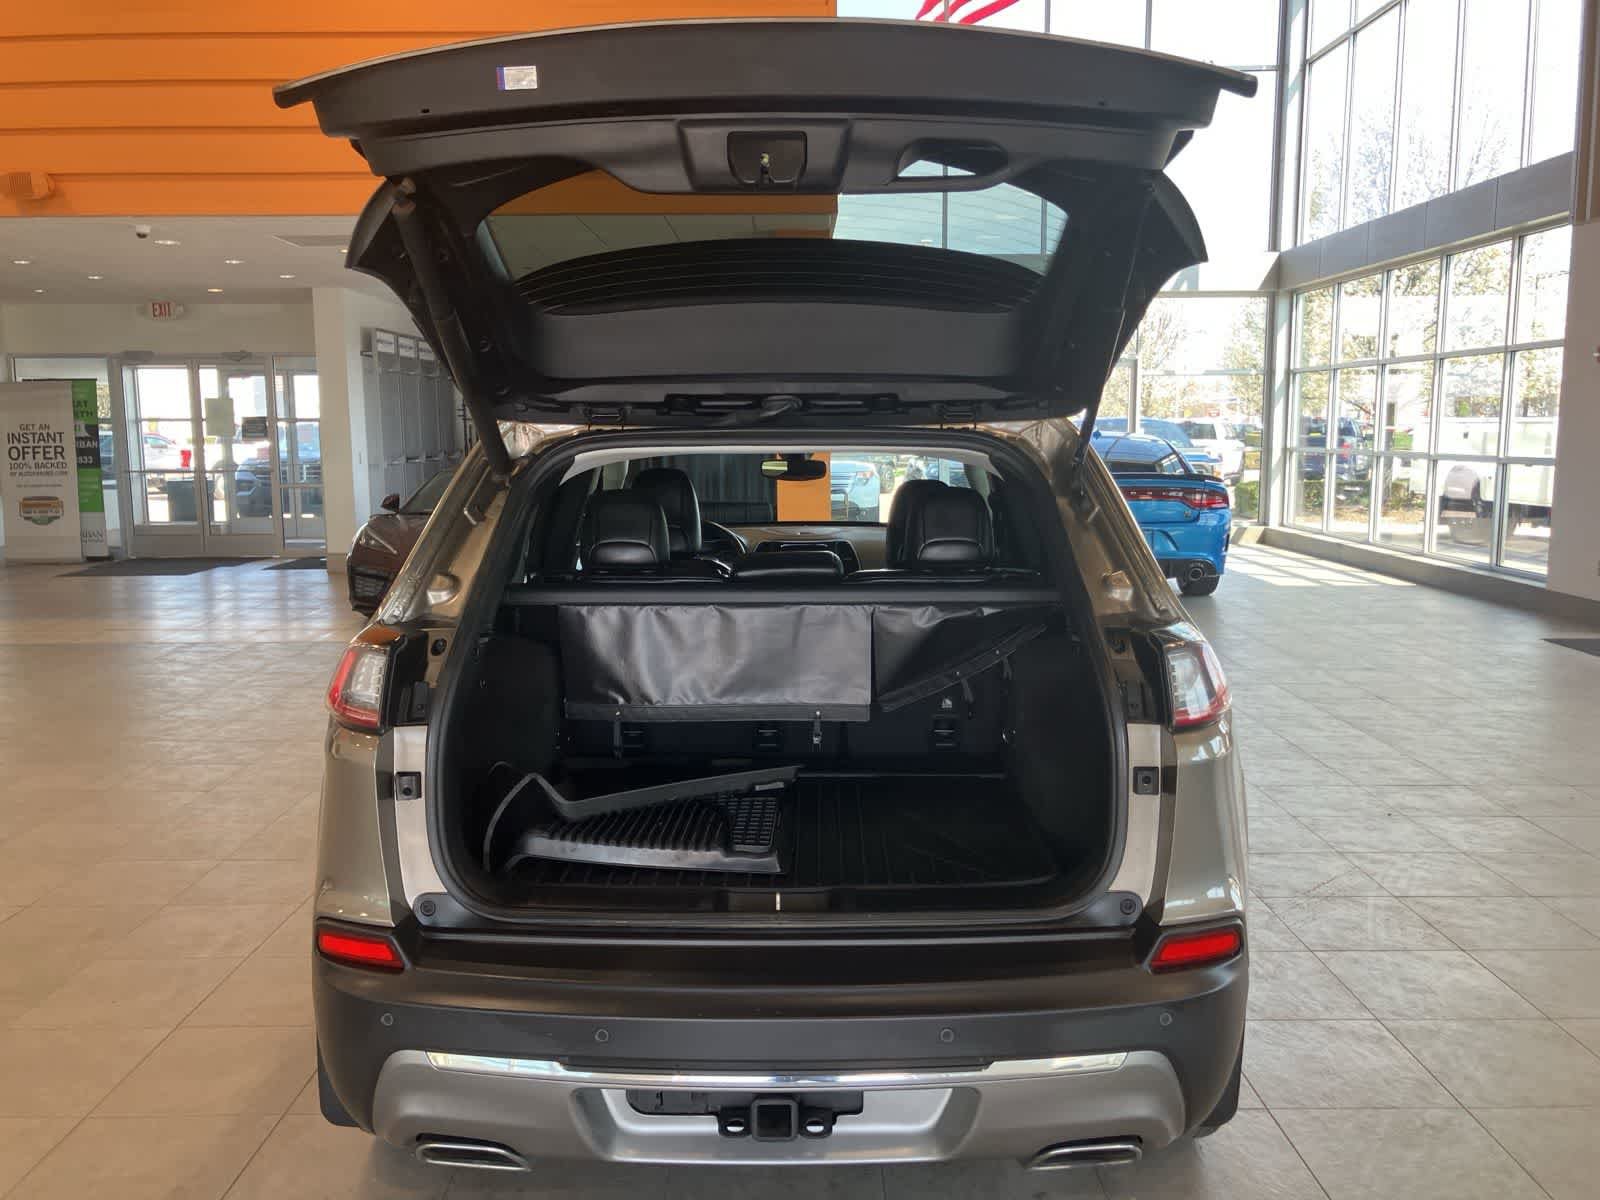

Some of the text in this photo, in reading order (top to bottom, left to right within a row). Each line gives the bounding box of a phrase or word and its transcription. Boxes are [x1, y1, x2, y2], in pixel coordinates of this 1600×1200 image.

[152, 302, 171, 317] EXIT
[19, 423, 50, 431] GET AN
[7, 431, 65, 444] INSTANT
[8, 445, 65, 461] OFFER
[9, 461, 68, 470] 100% BACKED
